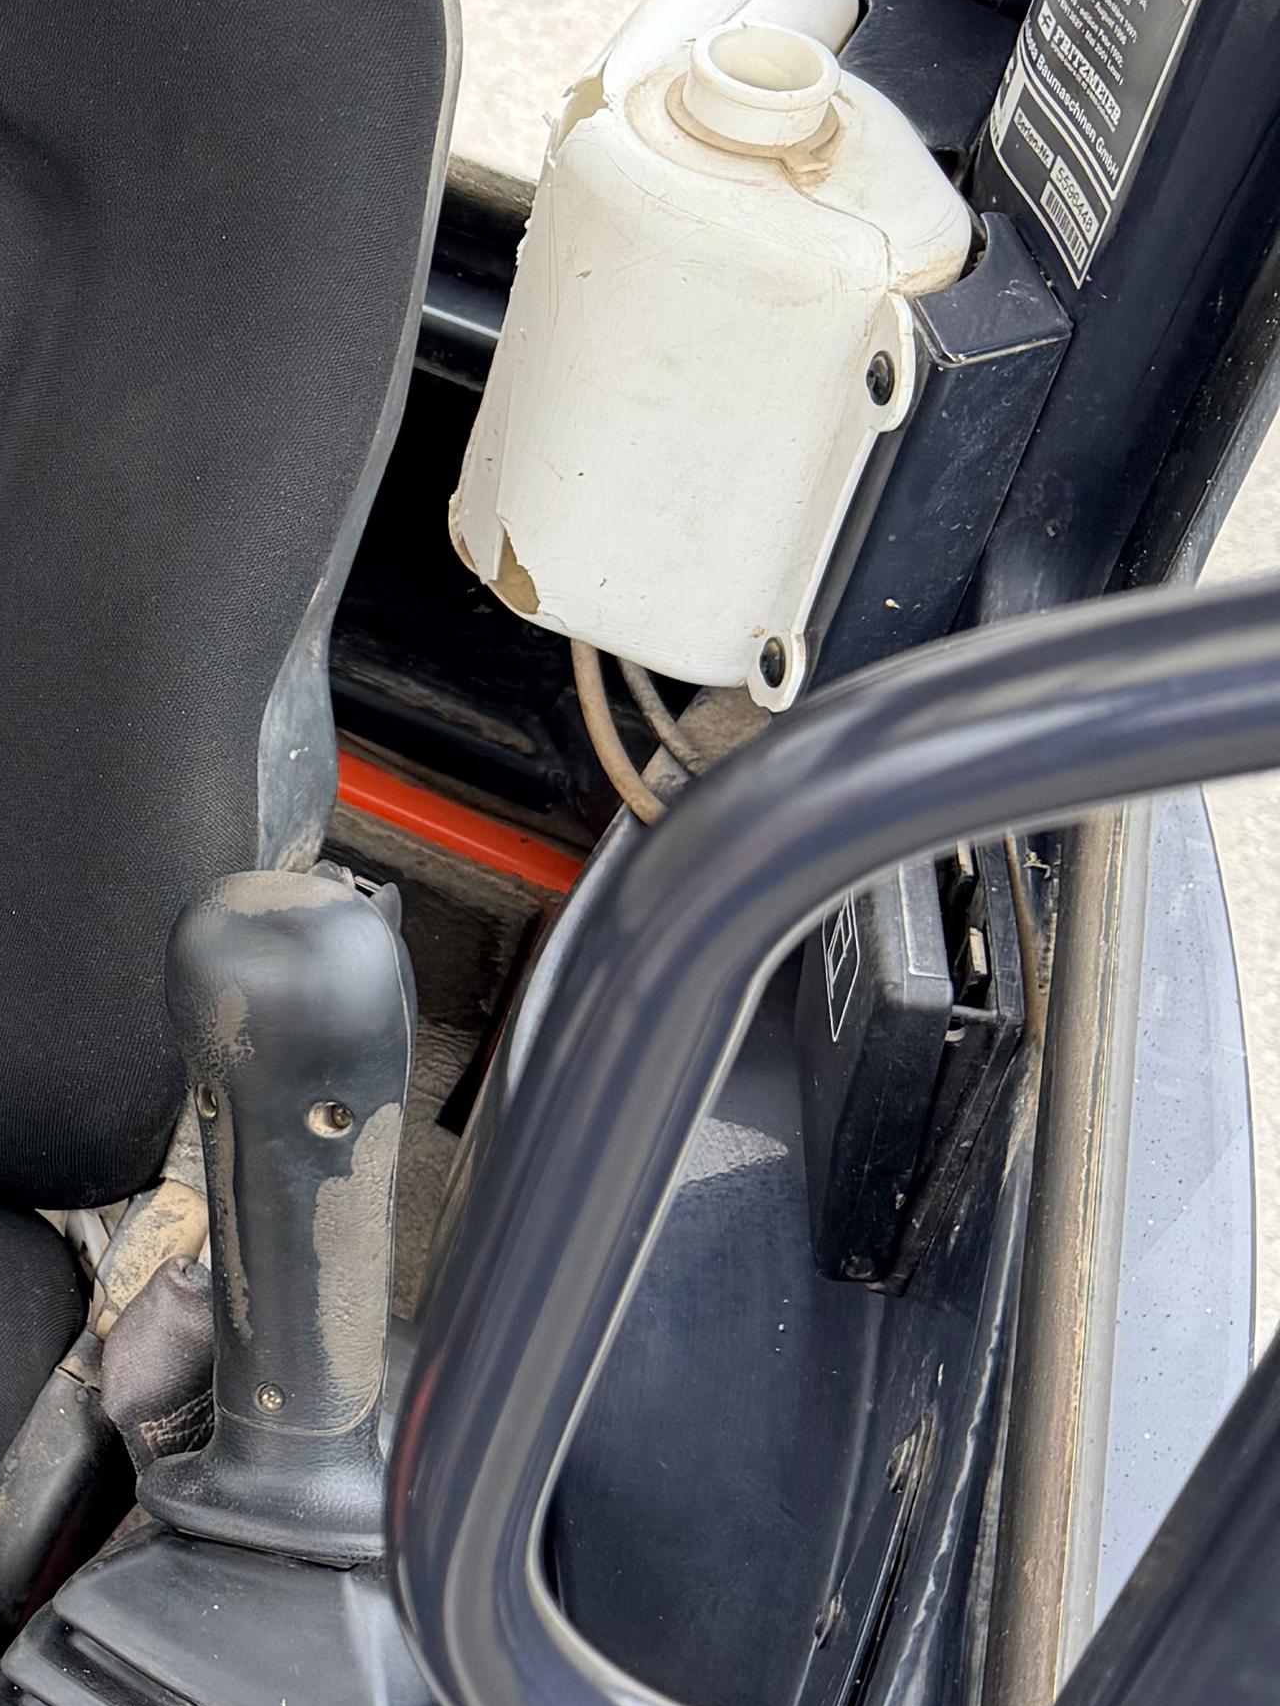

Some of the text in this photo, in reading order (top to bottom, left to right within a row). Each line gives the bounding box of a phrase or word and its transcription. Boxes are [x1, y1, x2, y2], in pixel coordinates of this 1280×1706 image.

[1036, 53, 1096, 143] Baumaschinen
[1094, 134, 1119, 181] GmbH
[1053, 23, 1122, 127] FRITZMEIER
